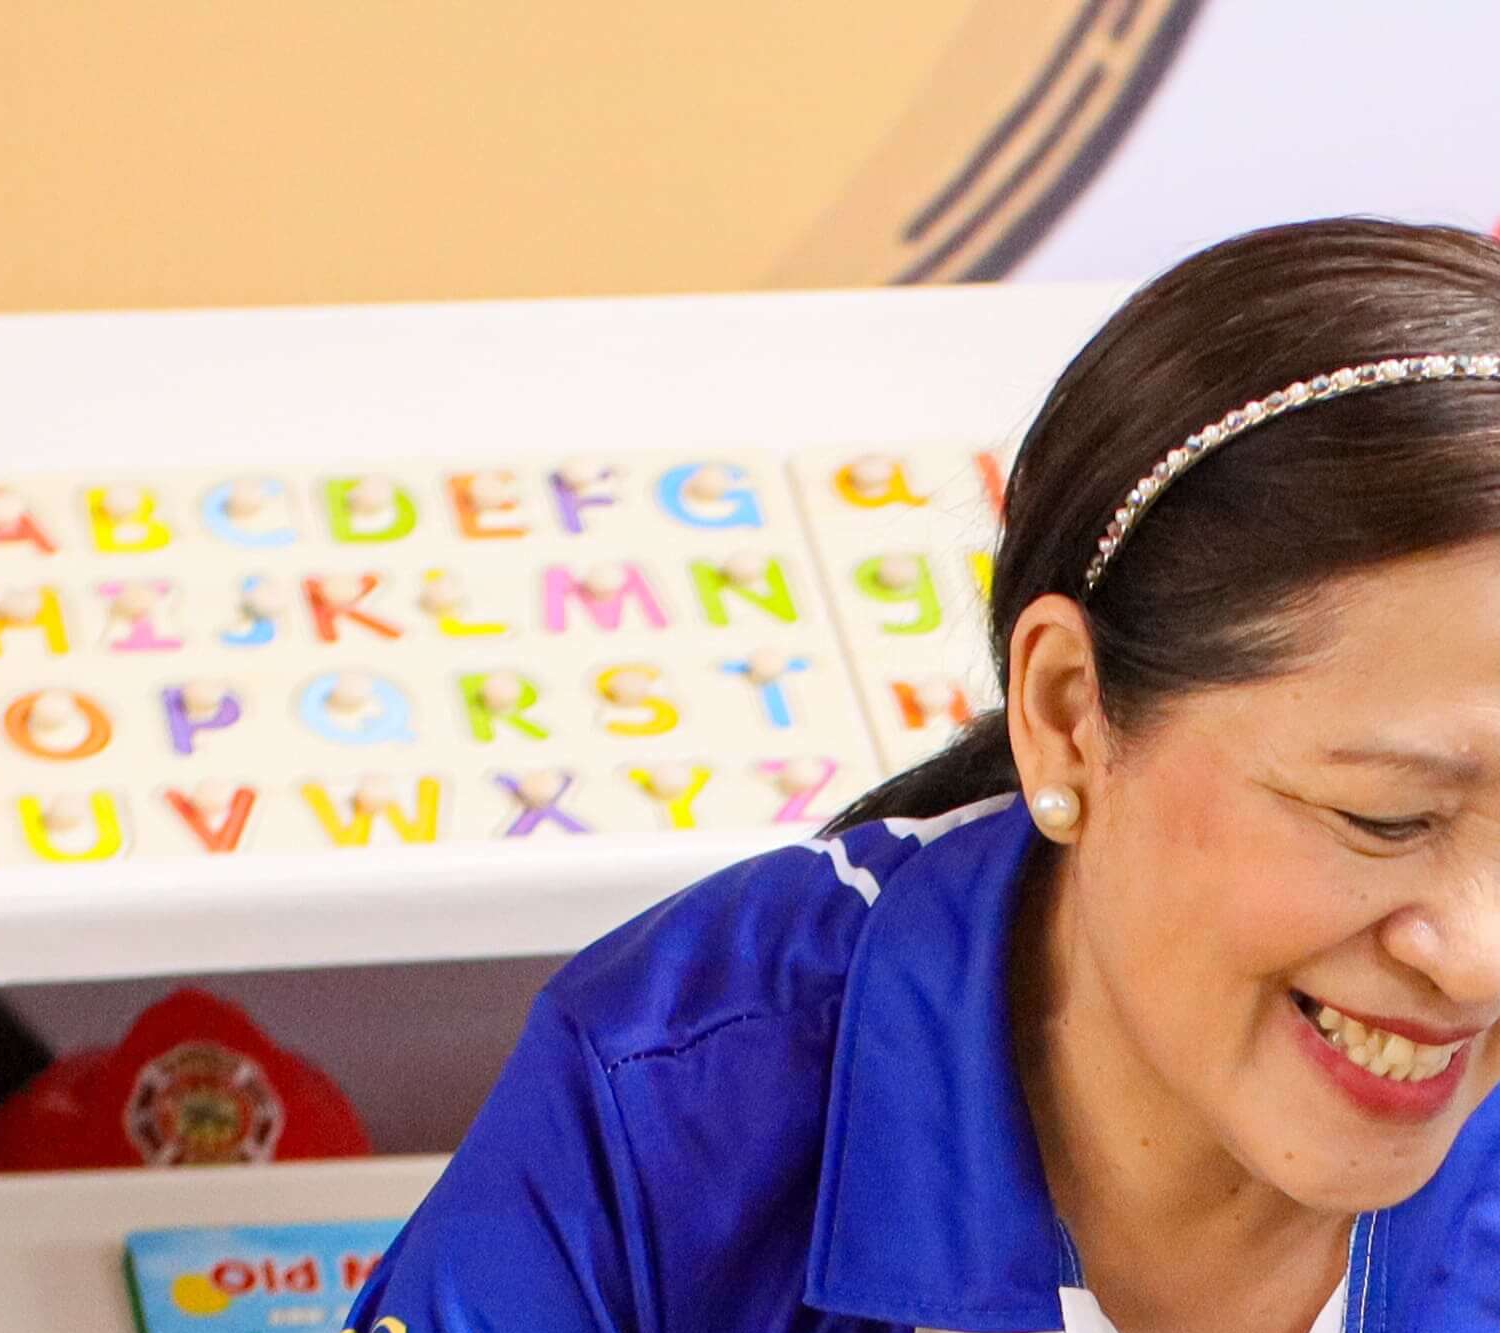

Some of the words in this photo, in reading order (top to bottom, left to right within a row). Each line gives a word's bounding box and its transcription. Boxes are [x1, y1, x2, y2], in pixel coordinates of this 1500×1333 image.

[84, 487, 174, 555] B
[201, 478, 298, 547] C
[325, 478, 418, 545] D
[445, 472, 527, 540] E
[548, 467, 618, 534] F
[655, 462, 765, 528] G
[831, 462, 929, 508] a
[97, 580, 183, 651] I
[219, 576, 272, 647] J
[303, 573, 404, 643] K
[419, 569, 507, 637] L
[539, 563, 668, 633] M
[695, 558, 800, 626] N
[854, 553, 943, 634] g
[3, 688, 113, 761] O
[161, 685, 242, 755] P
[299, 673, 415, 744] Q
[458, 672, 550, 743] R
[595, 664, 679, 737] S
[722, 658, 808, 728] T
[18, 793, 125, 863] U
[164, 787, 258, 853] V
[299, 778, 441, 849] W
[498, 772, 587, 838] X
[627, 766, 712, 831] Y
[752, 759, 839, 825] Z
[211, 1255, 319, 1296] Old
